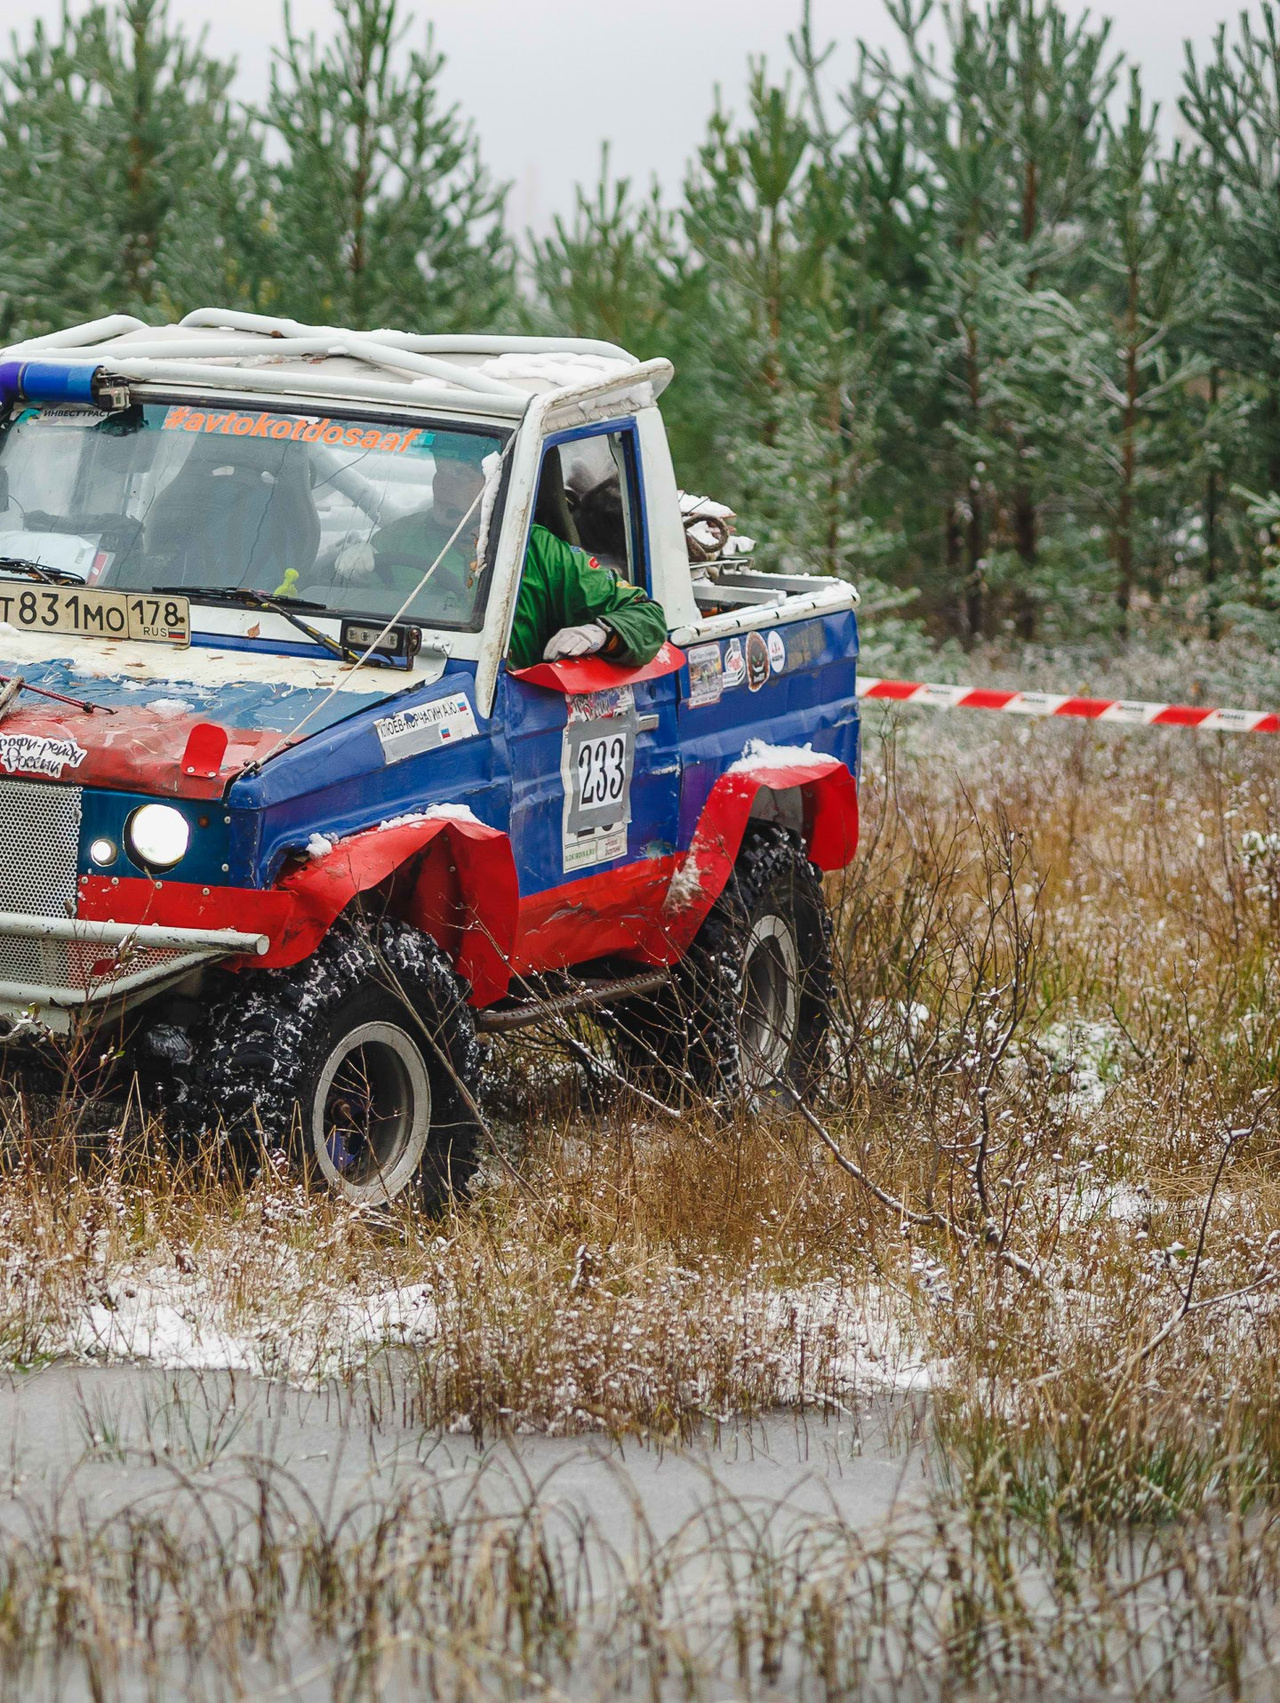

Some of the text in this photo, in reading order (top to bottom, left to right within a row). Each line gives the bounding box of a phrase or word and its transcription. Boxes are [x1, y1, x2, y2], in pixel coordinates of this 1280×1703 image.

[164, 405, 423, 453] #avtokotdosaaf
[131, 600, 179, 627] 178
[143, 626, 167, 638] RUS
[579, 738, 625, 805] 233
